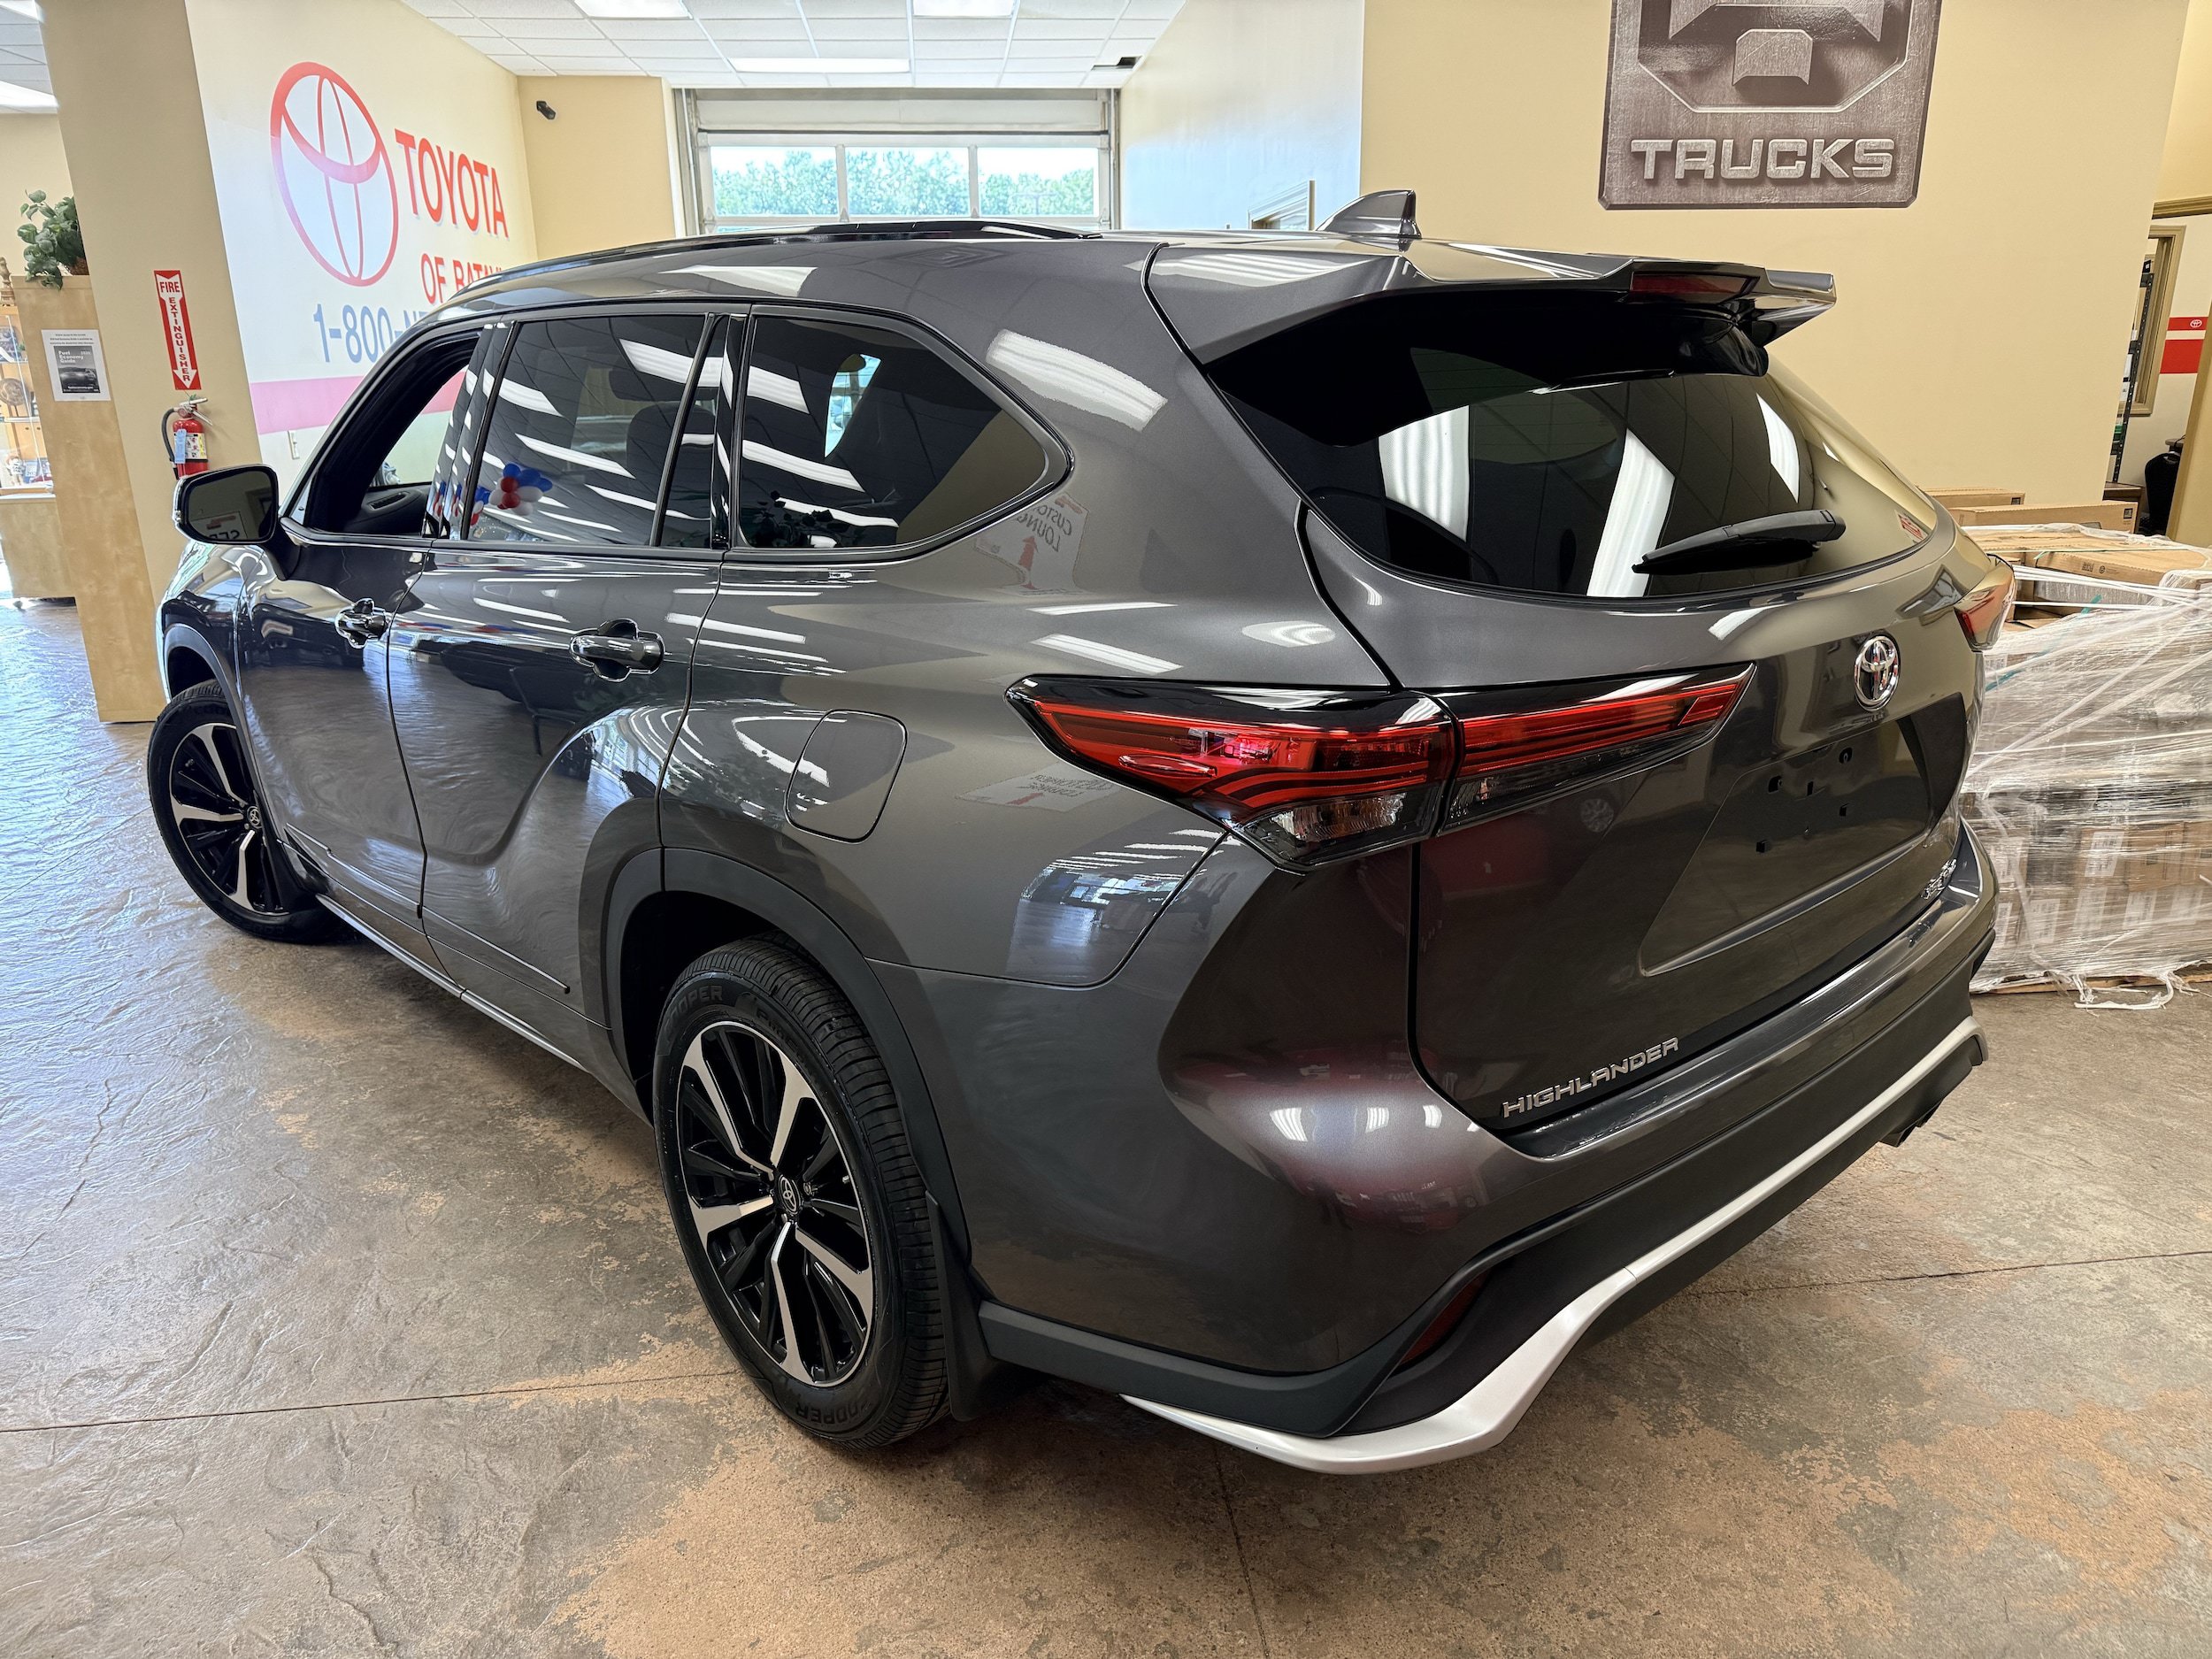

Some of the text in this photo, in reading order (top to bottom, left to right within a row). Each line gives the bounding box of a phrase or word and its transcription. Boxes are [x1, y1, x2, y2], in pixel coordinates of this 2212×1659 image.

[395, 127, 509, 238] TOYOTA
[1631, 138, 1895, 180] TRUCKS
[159, 281, 180, 293] FIRE
[420, 253, 446, 304] OF
[168, 296, 191, 381] EXTINGUISHER
[1500, 1036, 1679, 1119] HIGHLANDER
